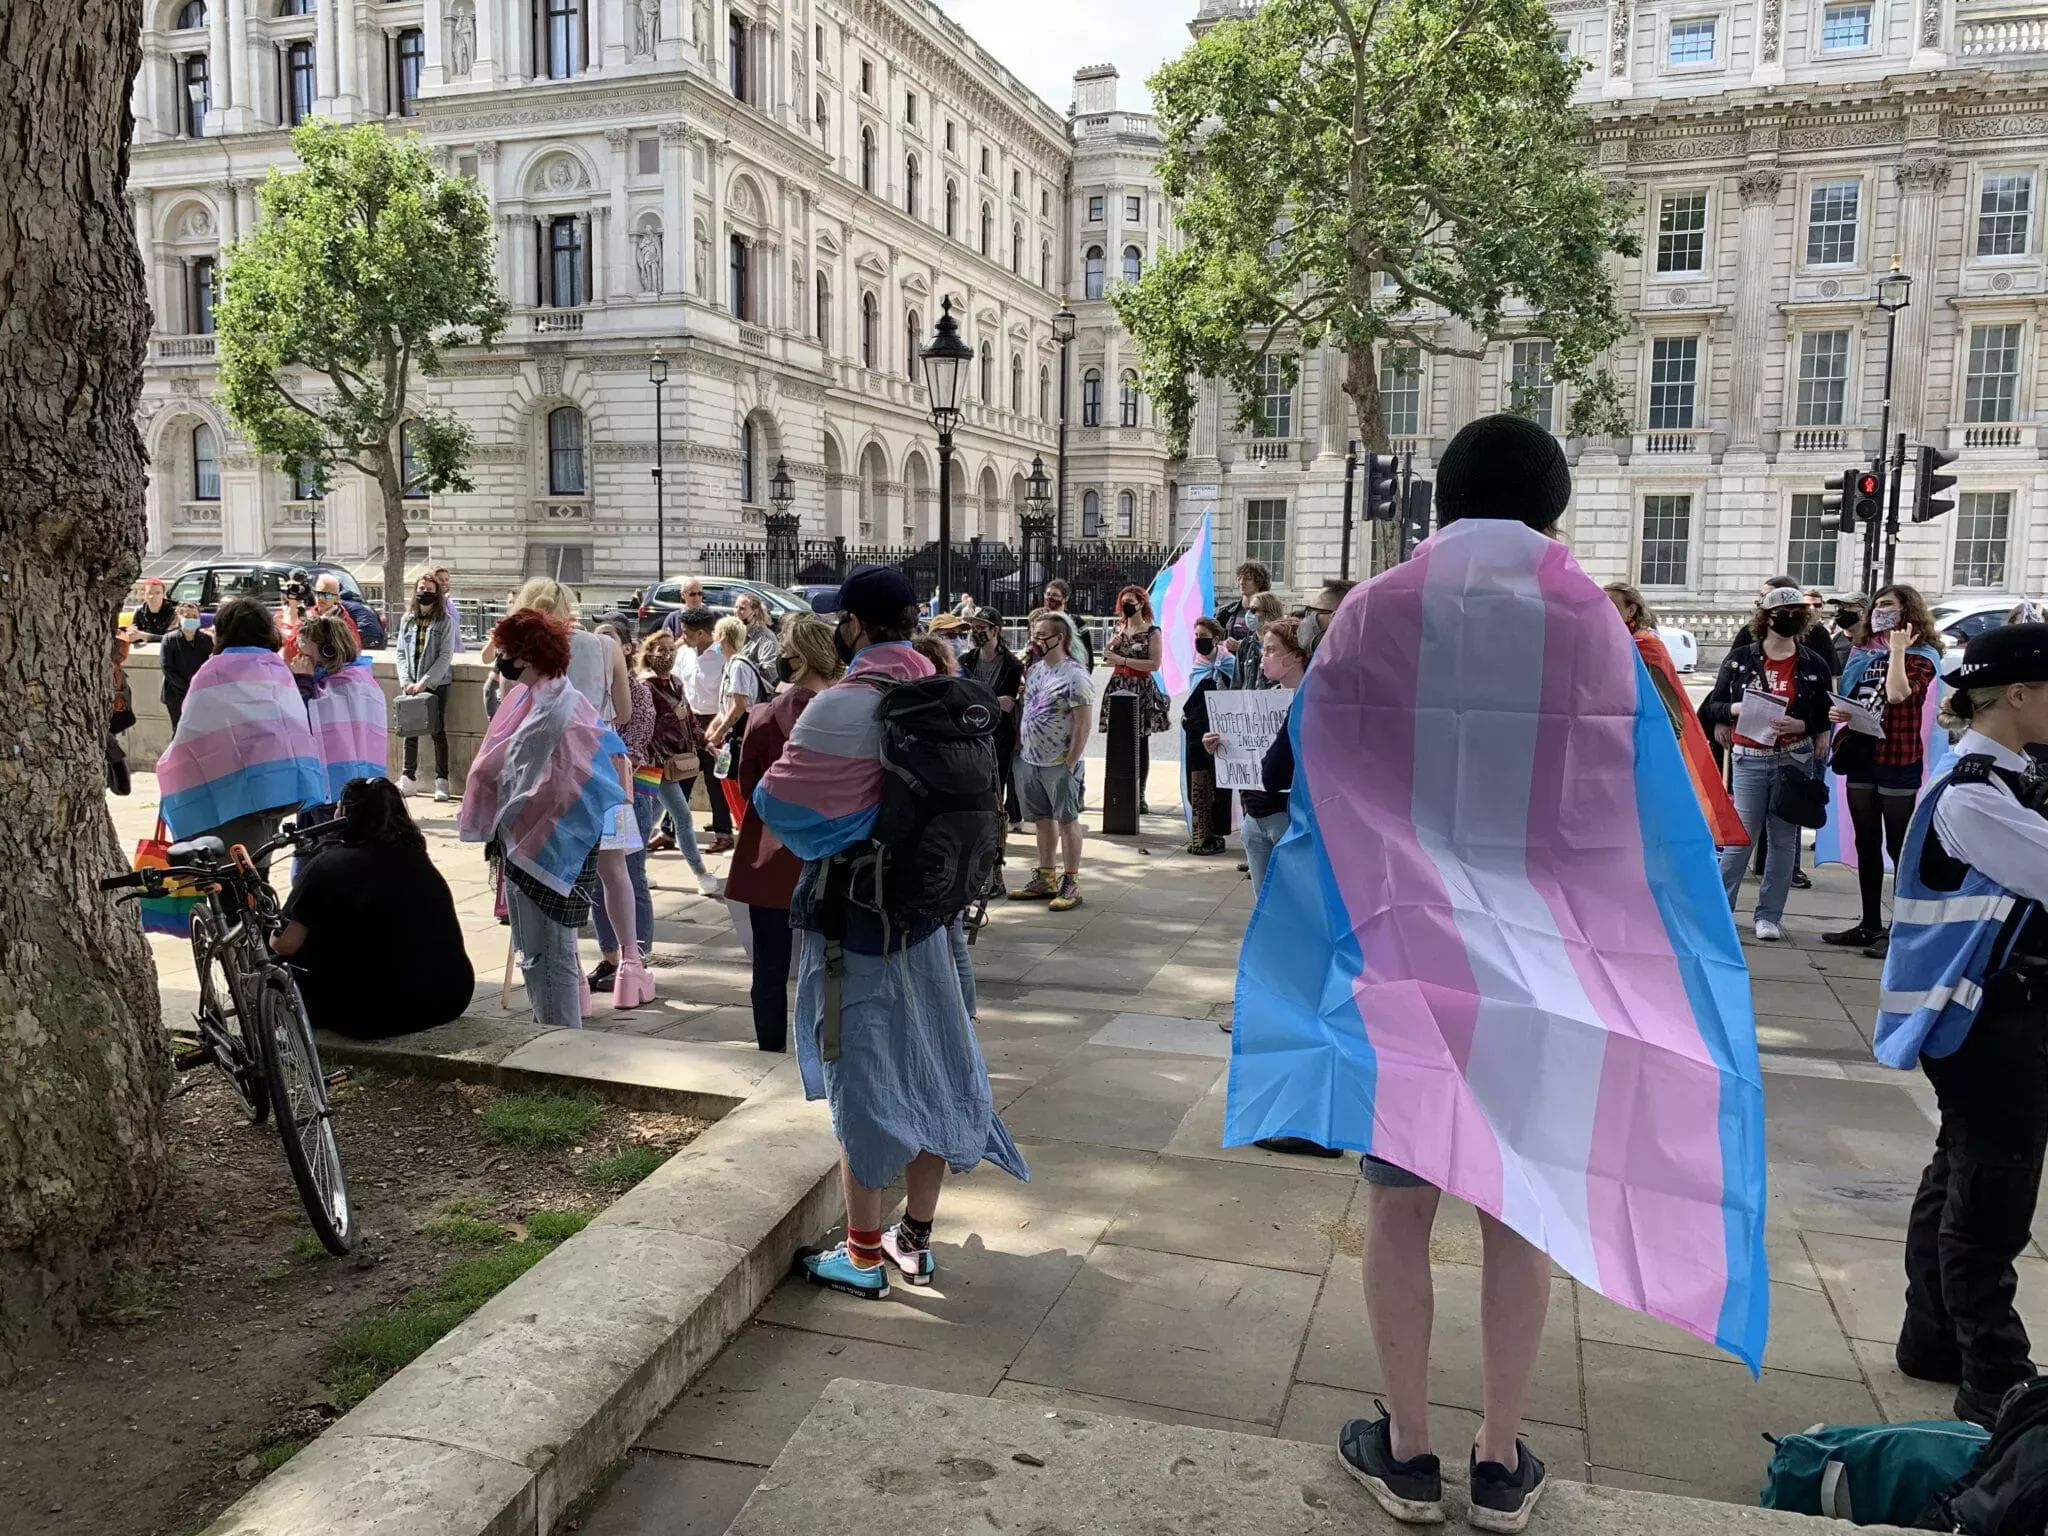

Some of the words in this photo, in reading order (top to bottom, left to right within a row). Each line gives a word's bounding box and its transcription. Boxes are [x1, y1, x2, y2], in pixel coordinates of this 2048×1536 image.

[1208, 697, 1260, 733] PROTECTING
[1238, 734, 1270, 747] INCLUDES
[1216, 743, 1251, 785] SAVING
